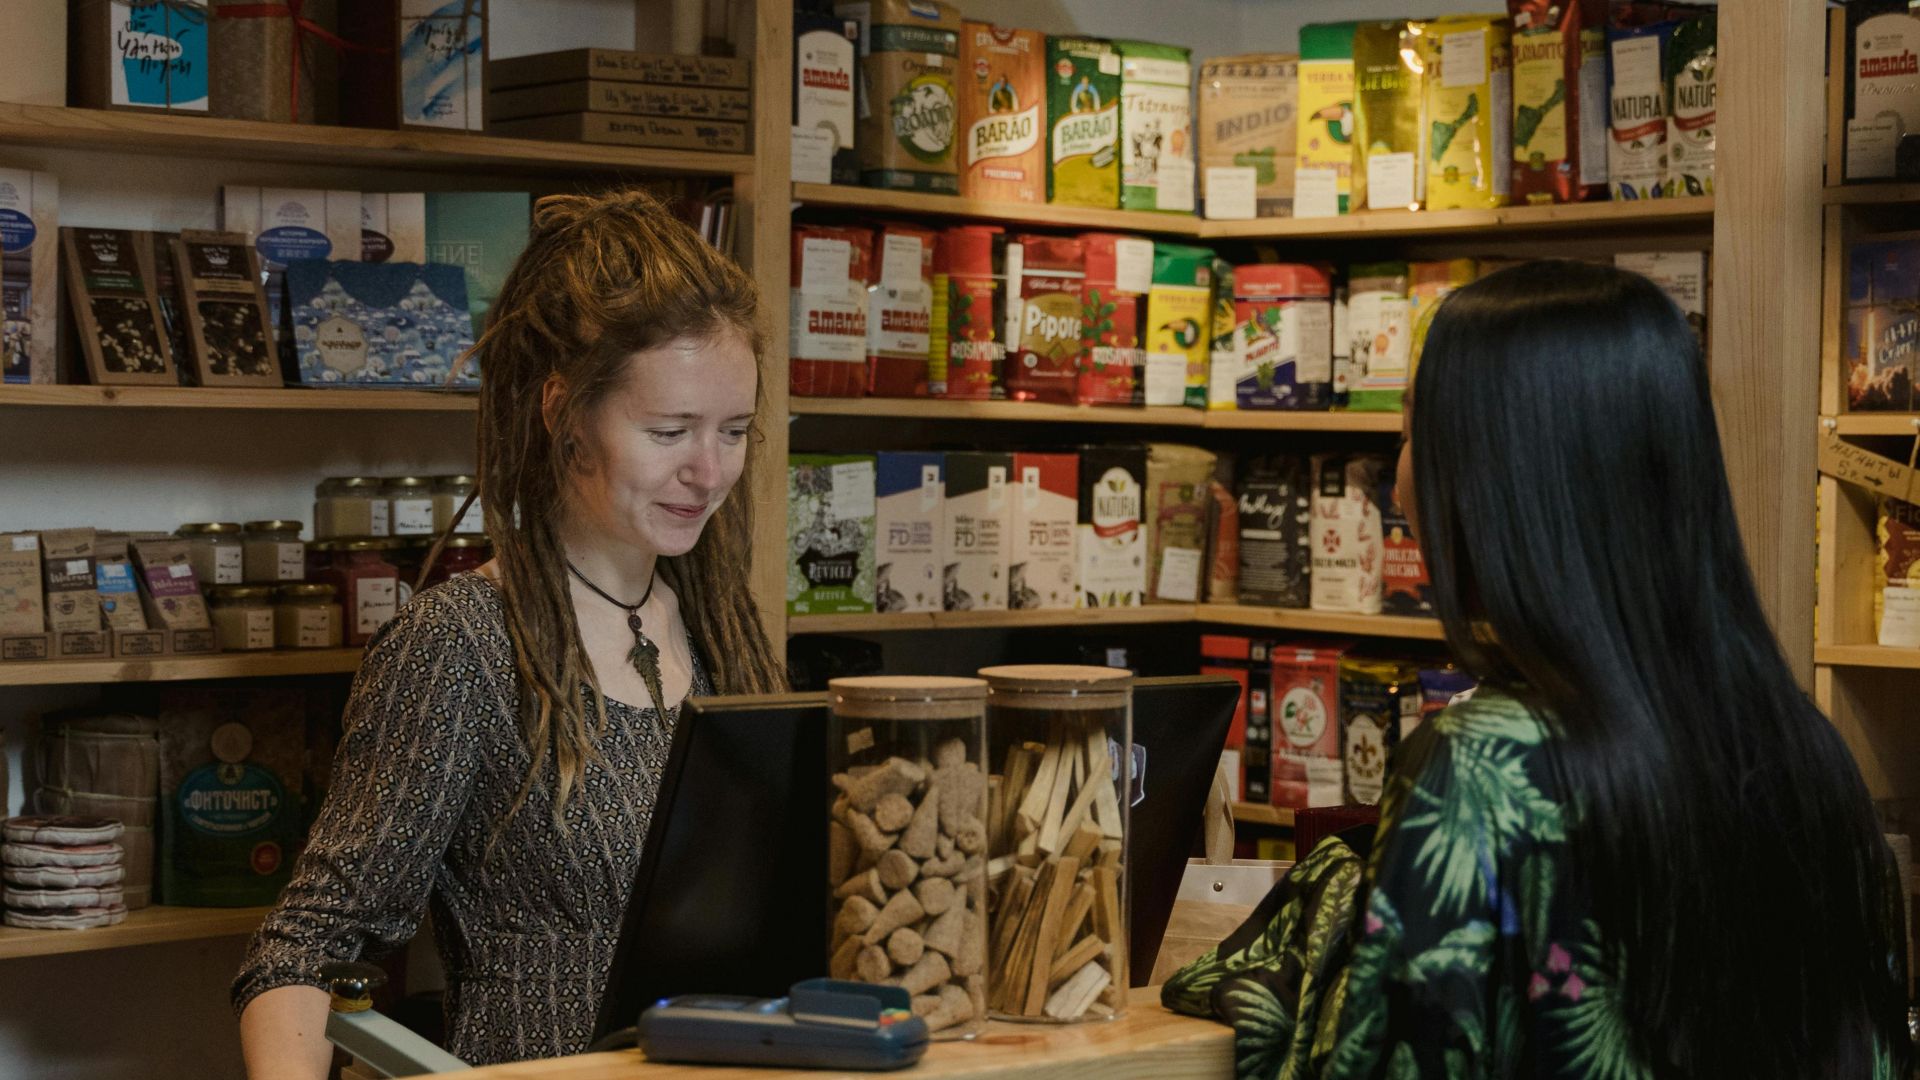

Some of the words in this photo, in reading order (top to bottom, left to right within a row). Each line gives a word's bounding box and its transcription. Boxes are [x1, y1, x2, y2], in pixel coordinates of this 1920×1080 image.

[1859, 50, 1918, 77] amanda
[803, 68, 849, 90] amanda
[1613, 95, 1662, 119] NATURA
[1679, 85, 1717, 109] NATUR
[976, 117, 1032, 147] BARÃO
[1060, 116, 1112, 145] BARÃO
[426, 245, 480, 265] НИЕ
[1099, 496, 1136, 518] NATURA
